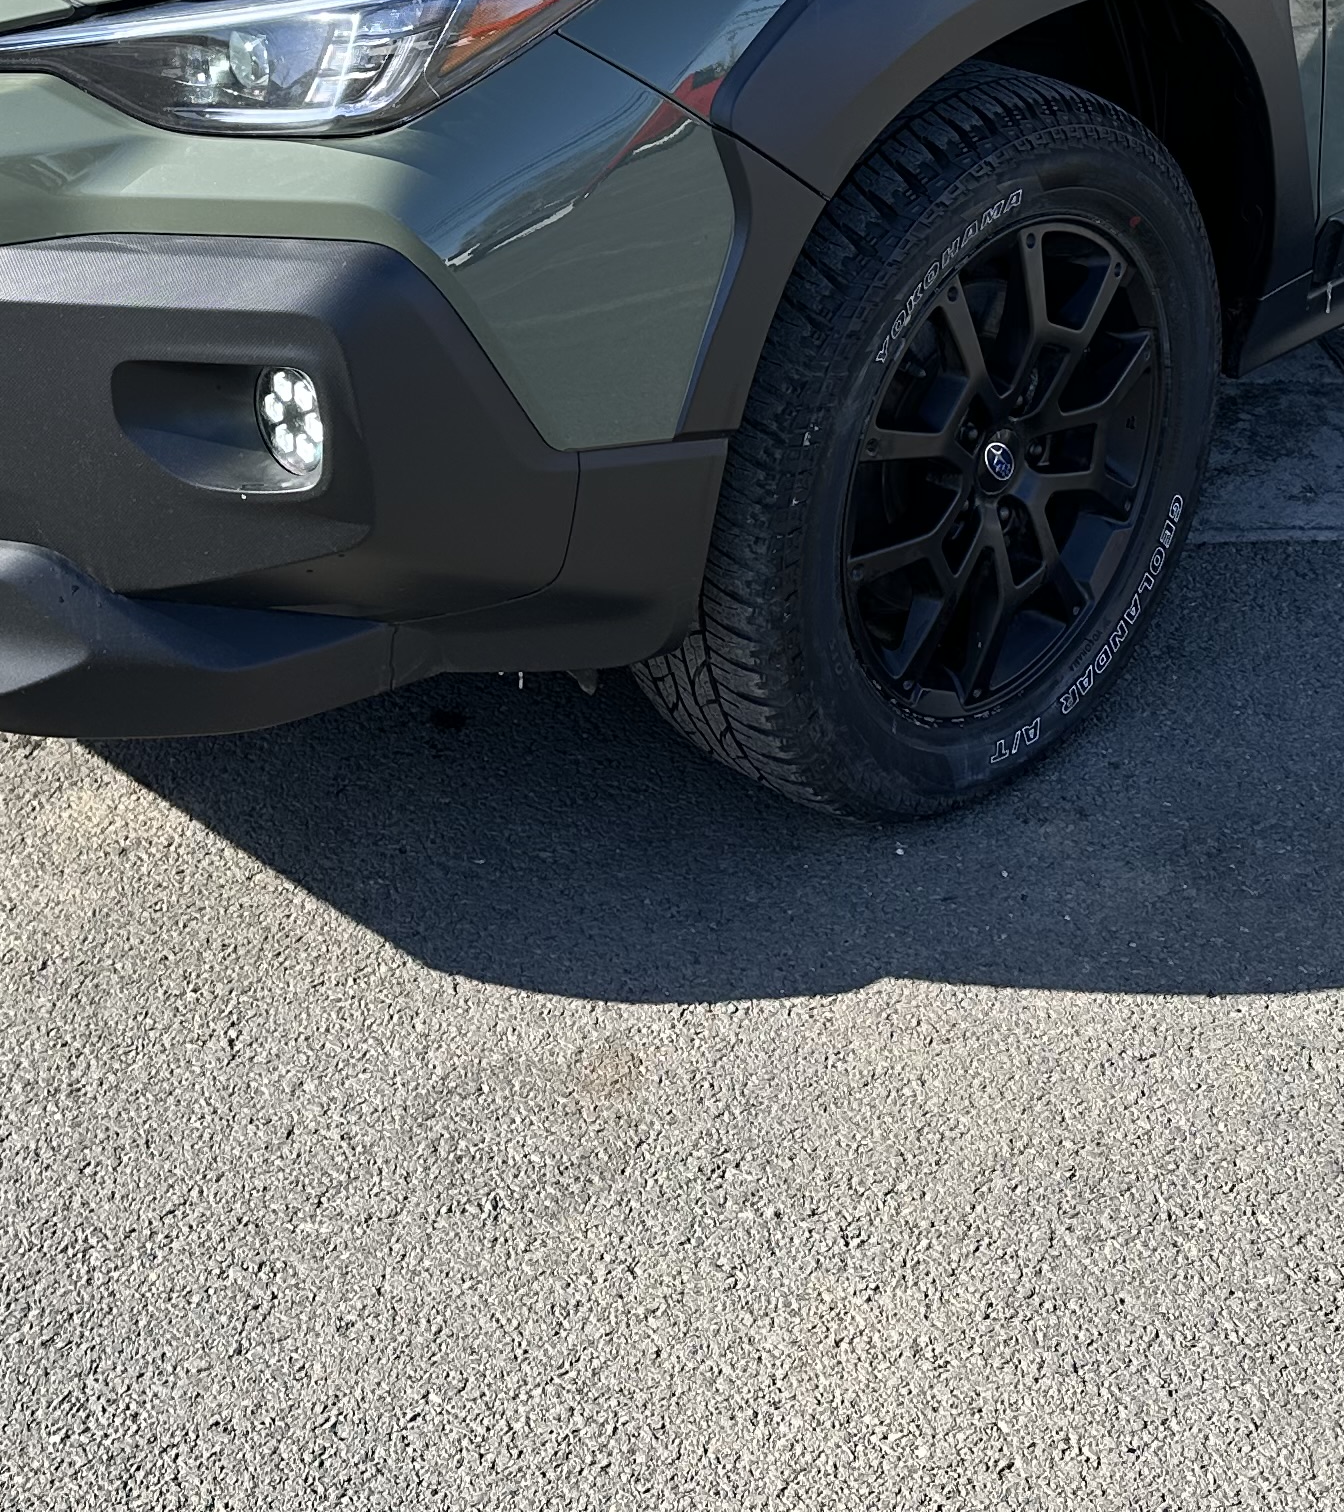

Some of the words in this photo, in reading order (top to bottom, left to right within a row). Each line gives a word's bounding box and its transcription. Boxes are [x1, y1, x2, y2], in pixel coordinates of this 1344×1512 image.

[875, 188, 1023, 364] YOKOHAMA
[1059, 494, 1184, 715] GEOLANDAR
[990, 717, 1041, 764] A/T
